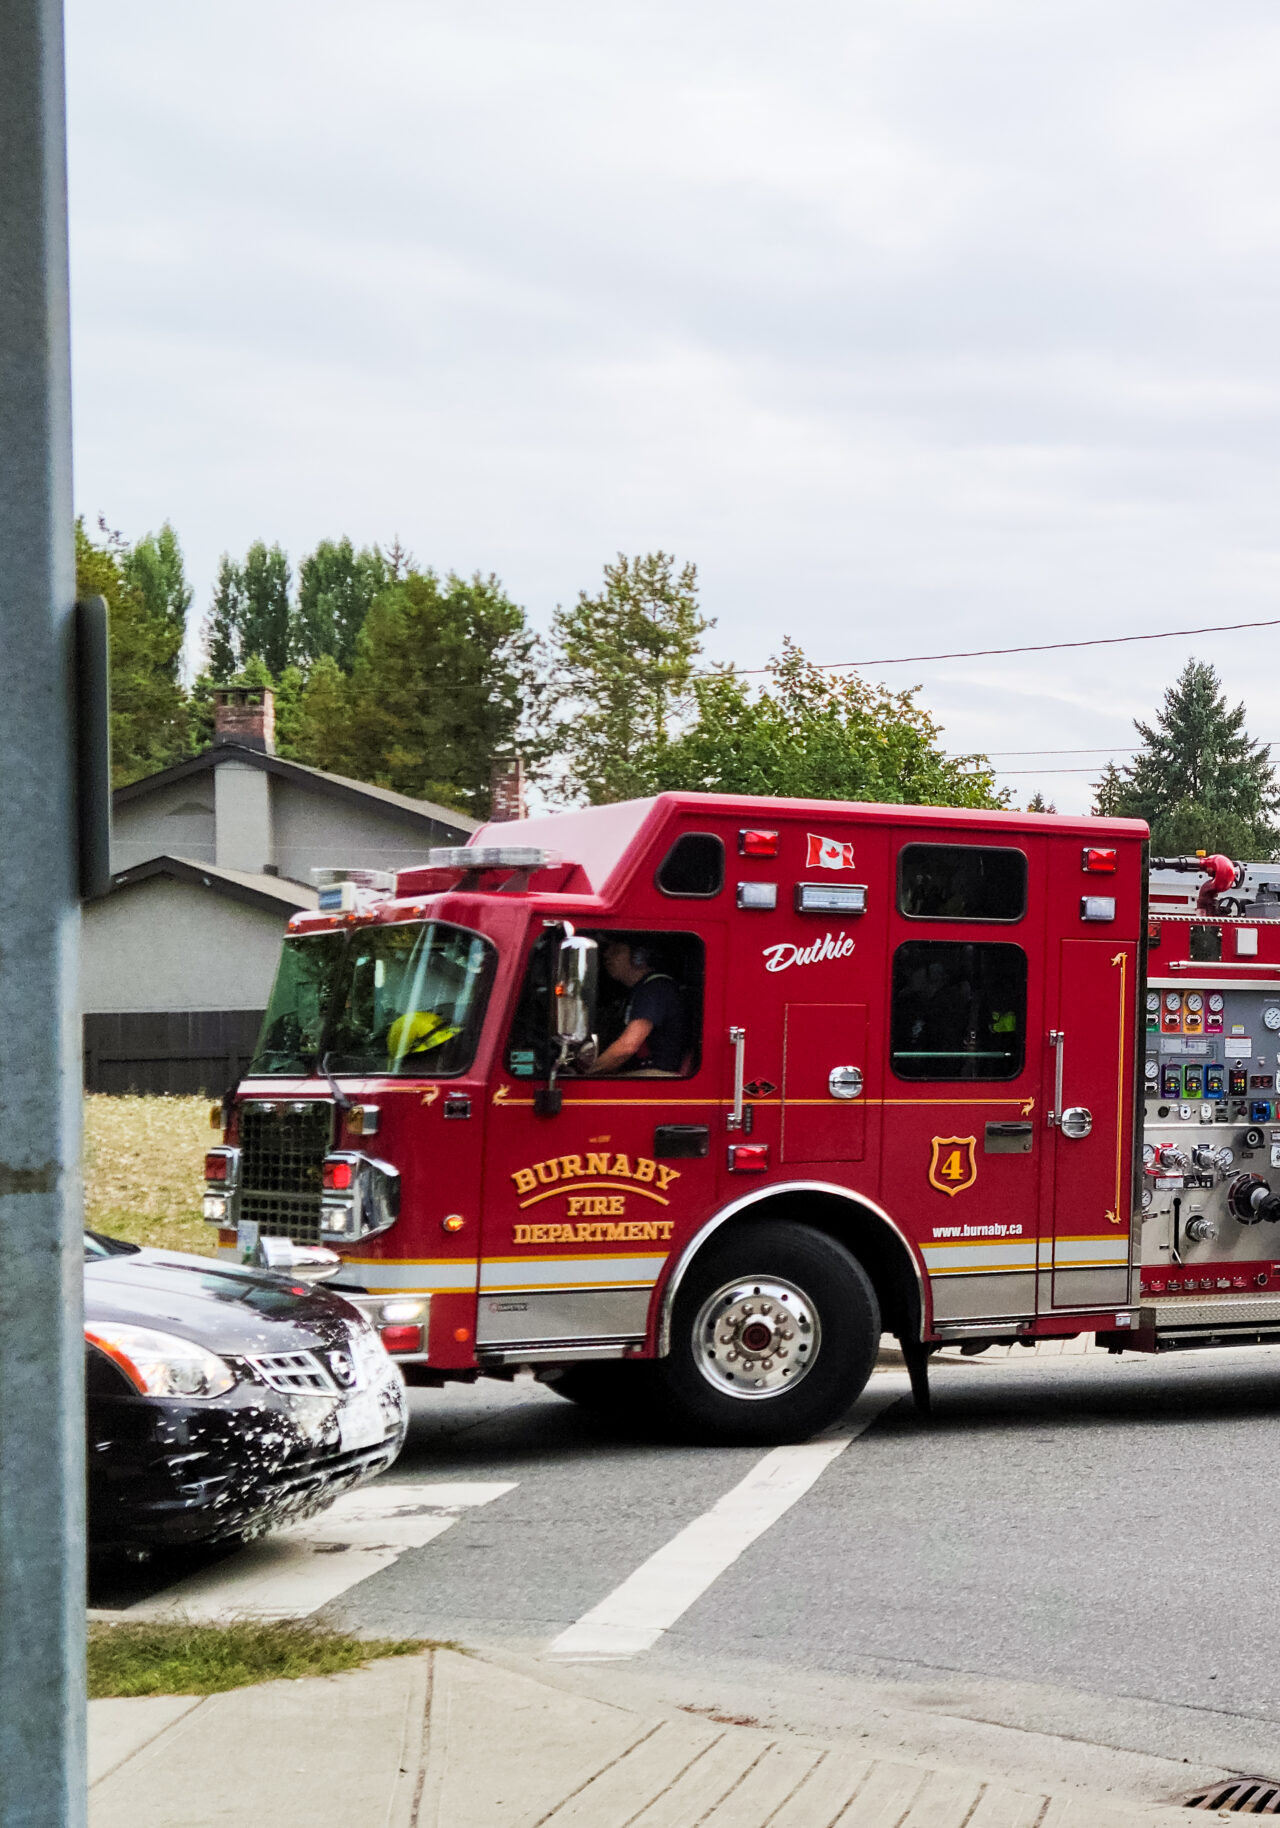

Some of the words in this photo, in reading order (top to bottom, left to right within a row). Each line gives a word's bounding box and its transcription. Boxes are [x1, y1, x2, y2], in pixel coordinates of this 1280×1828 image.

[762, 931, 856, 972] Duthie
[511, 1152, 681, 1195] BURNABY
[941, 1150, 964, 1180] 4
[567, 1196, 626, 1217] FIRE
[513, 1221, 674, 1244] DEPARTMENT
[932, 1223, 1023, 1238] www.burnaby.ca
